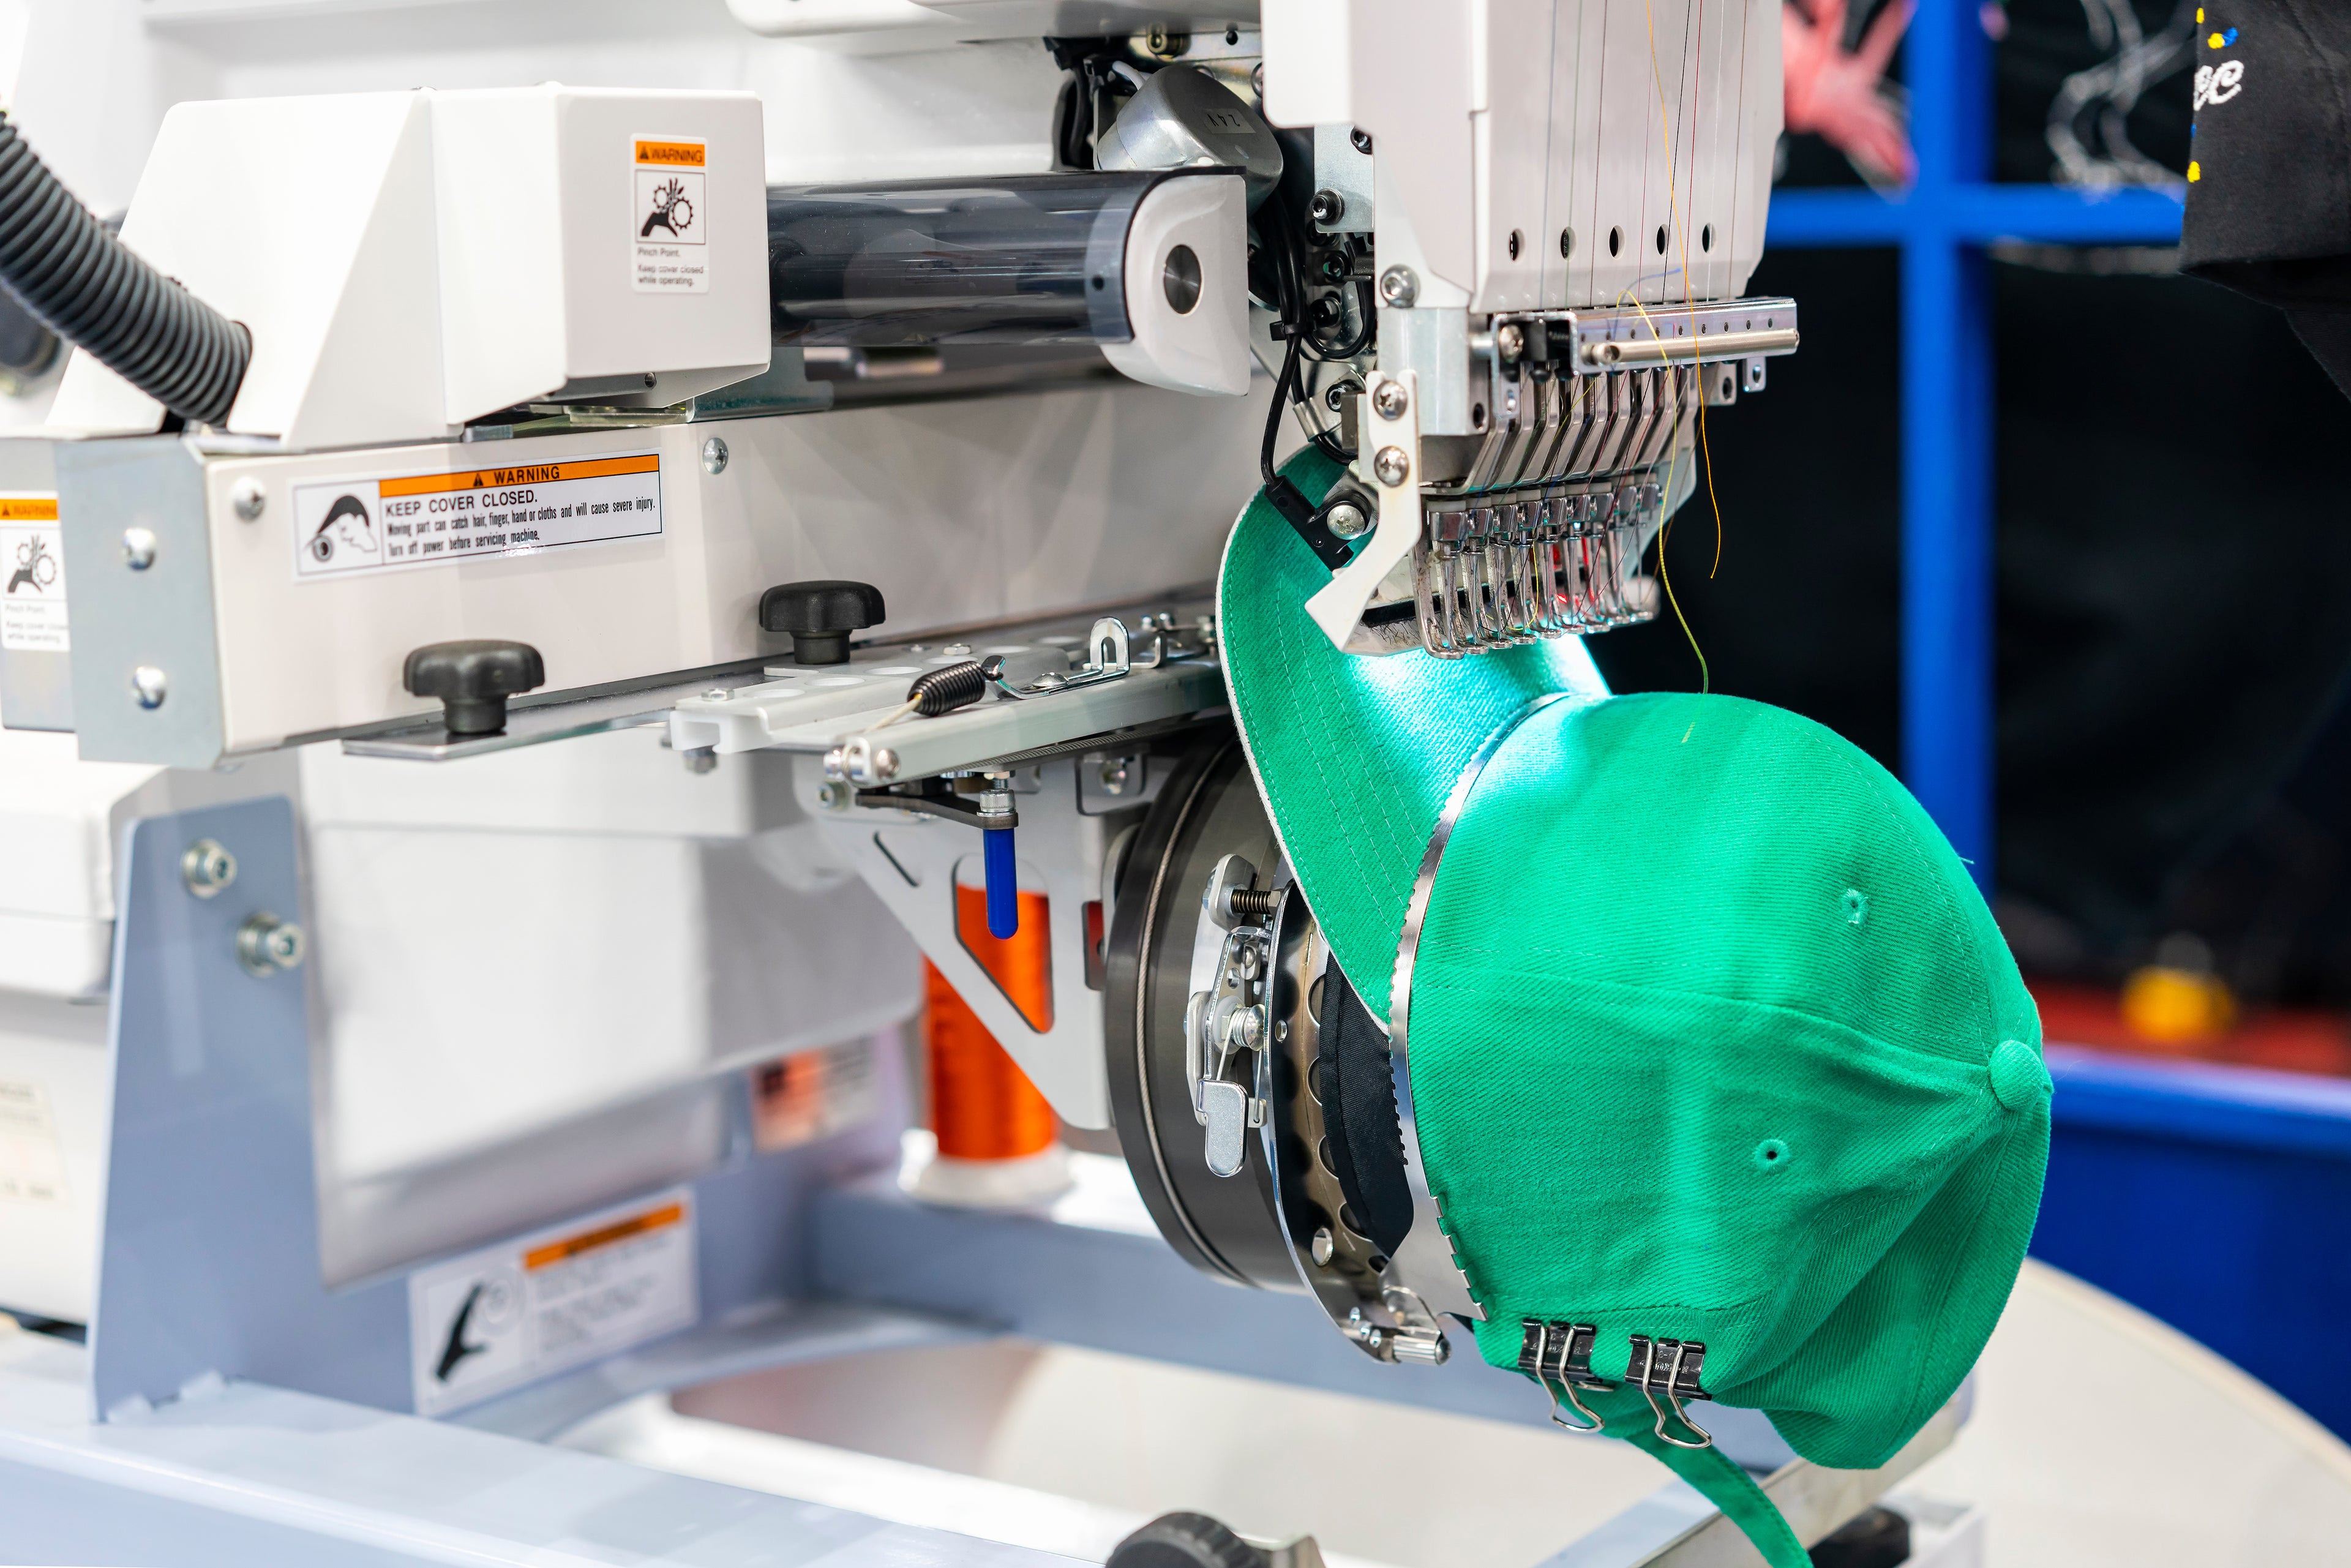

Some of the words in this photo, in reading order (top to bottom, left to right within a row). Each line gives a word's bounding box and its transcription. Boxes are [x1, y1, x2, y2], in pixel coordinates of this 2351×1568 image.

[1207, 113, 1240, 127] 24V
[650, 148, 703, 163] WARNING
[637, 247, 658, 257] Pinch
[680, 265, 703, 274] closed
[494, 466, 560, 484] WARNING
[386, 501, 421, 517] KEEP
[429, 495, 474, 513] COVER
[482, 490, 538, 508] CLOSED.
[387, 523, 411, 538] Moving
[417, 521, 430, 535] part
[435, 520, 446, 531] can
[452, 514, 468, 530] catch
[473, 513, 487, 528] hair,
[489, 512, 509, 528] finger,
[512, 509, 527, 523] hand
[529, 511, 536, 522] or
[538, 506, 557, 520] cloths
[561, 504, 572, 518] and
[576, 502, 587, 516] will
[591, 503, 609, 515] cause
[613, 500, 632, 512] severe
[636, 496, 655, 512] injury.
[389, 543, 403, 557] Turn
[408, 539, 418, 554] off
[423, 541, 444, 555] power
[449, 536, 471, 550] before
[475, 532, 506, 548] servicing
[511, 528, 539, 543] machine.
